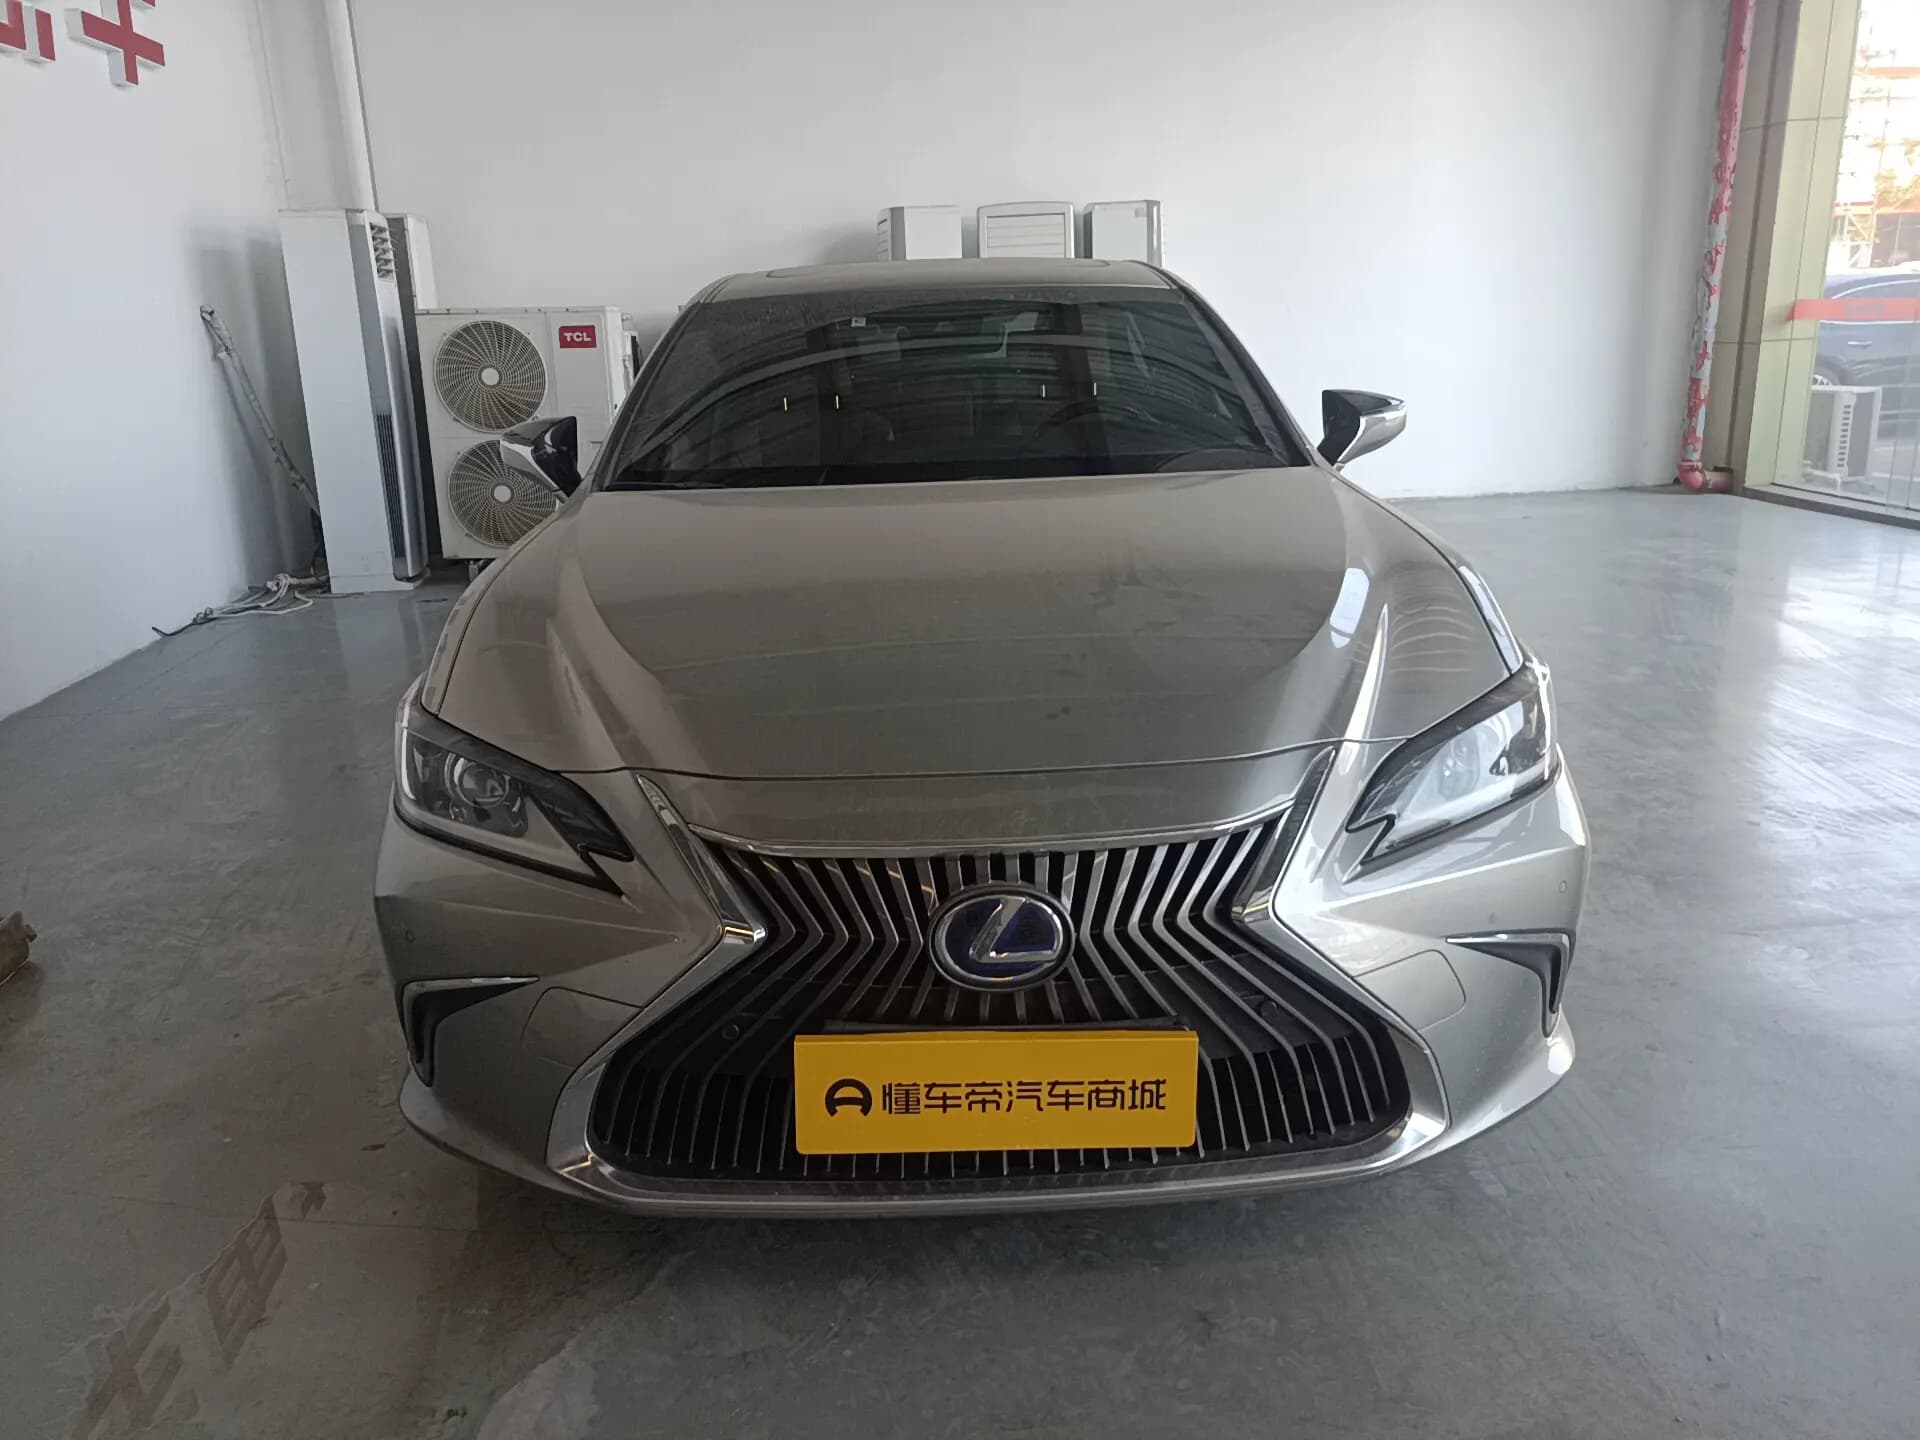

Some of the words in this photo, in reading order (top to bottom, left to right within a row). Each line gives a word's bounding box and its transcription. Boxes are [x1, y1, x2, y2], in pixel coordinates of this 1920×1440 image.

[563, 331, 592, 342] TCL
[882, 1079, 1167, 1115] 懂车帝汽车商城
